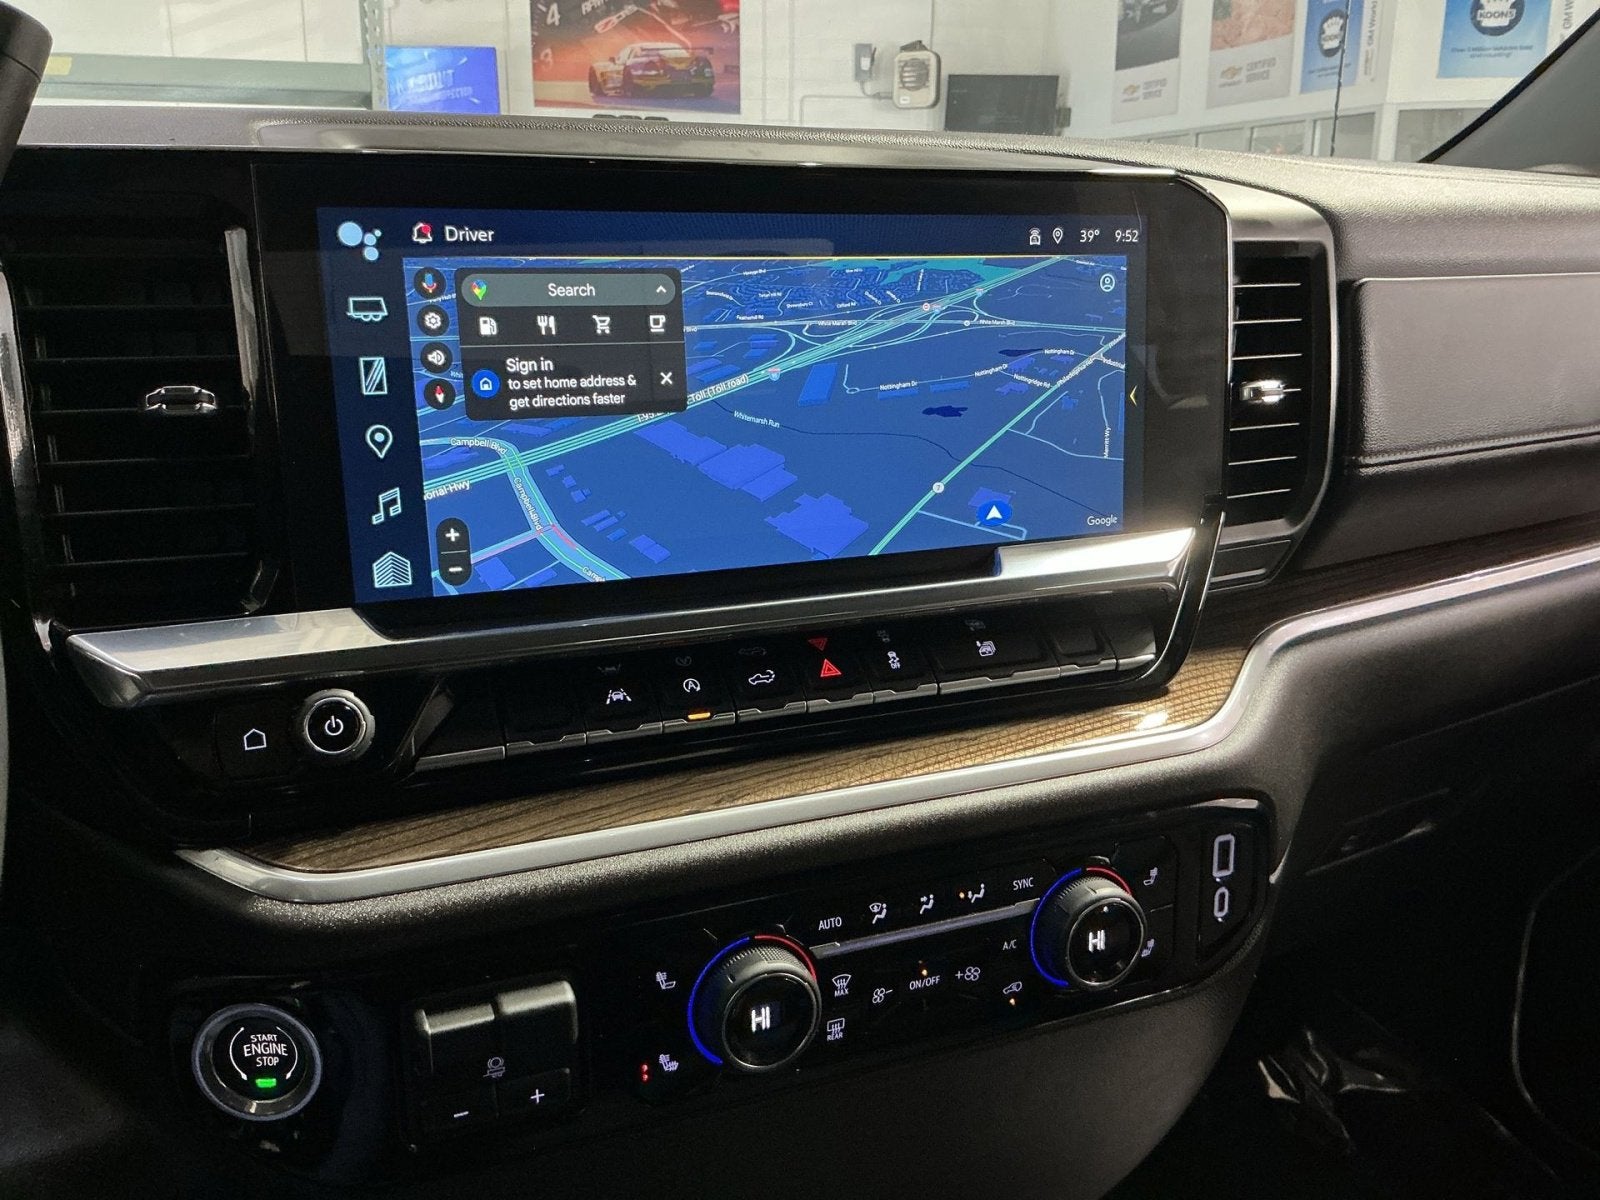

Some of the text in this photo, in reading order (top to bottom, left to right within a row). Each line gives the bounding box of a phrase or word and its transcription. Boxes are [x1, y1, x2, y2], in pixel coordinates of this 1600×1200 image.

[1478, 10, 1515, 19] KOONS
[444, 225, 495, 242] Driver
[1115, 229, 1139, 243] 9:52
[547, 283, 596, 297] Search
[506, 357, 554, 375] Sign in
[508, 374, 637, 390] to set home address &
[879, 382, 910, 391] Nottingham
[509, 392, 626, 411] get directions faster
[733, 410, 780, 428] Whitemarsh Run
[450, 437, 507, 455] Campbell Blvd
[449, 480, 471, 492] Hwy
[514, 477, 543, 531] Campbell Blvd
[1086, 514, 1118, 527] Google
[1012, 877, 1034, 890] SYNC
[818, 917, 842, 931] AUTO
[1002, 939, 1017, 951] A/C
[1088, 929, 1106, 952] HI
[909, 975, 941, 991] ON/OFF
[834, 987, 849, 998] MAX
[751, 1006, 771, 1032] HI
[250, 1034, 277, 1042] START
[826, 1031, 843, 1041] REAR
[243, 1042, 288, 1057] ENGINE
[256, 1056, 280, 1067] STOP
